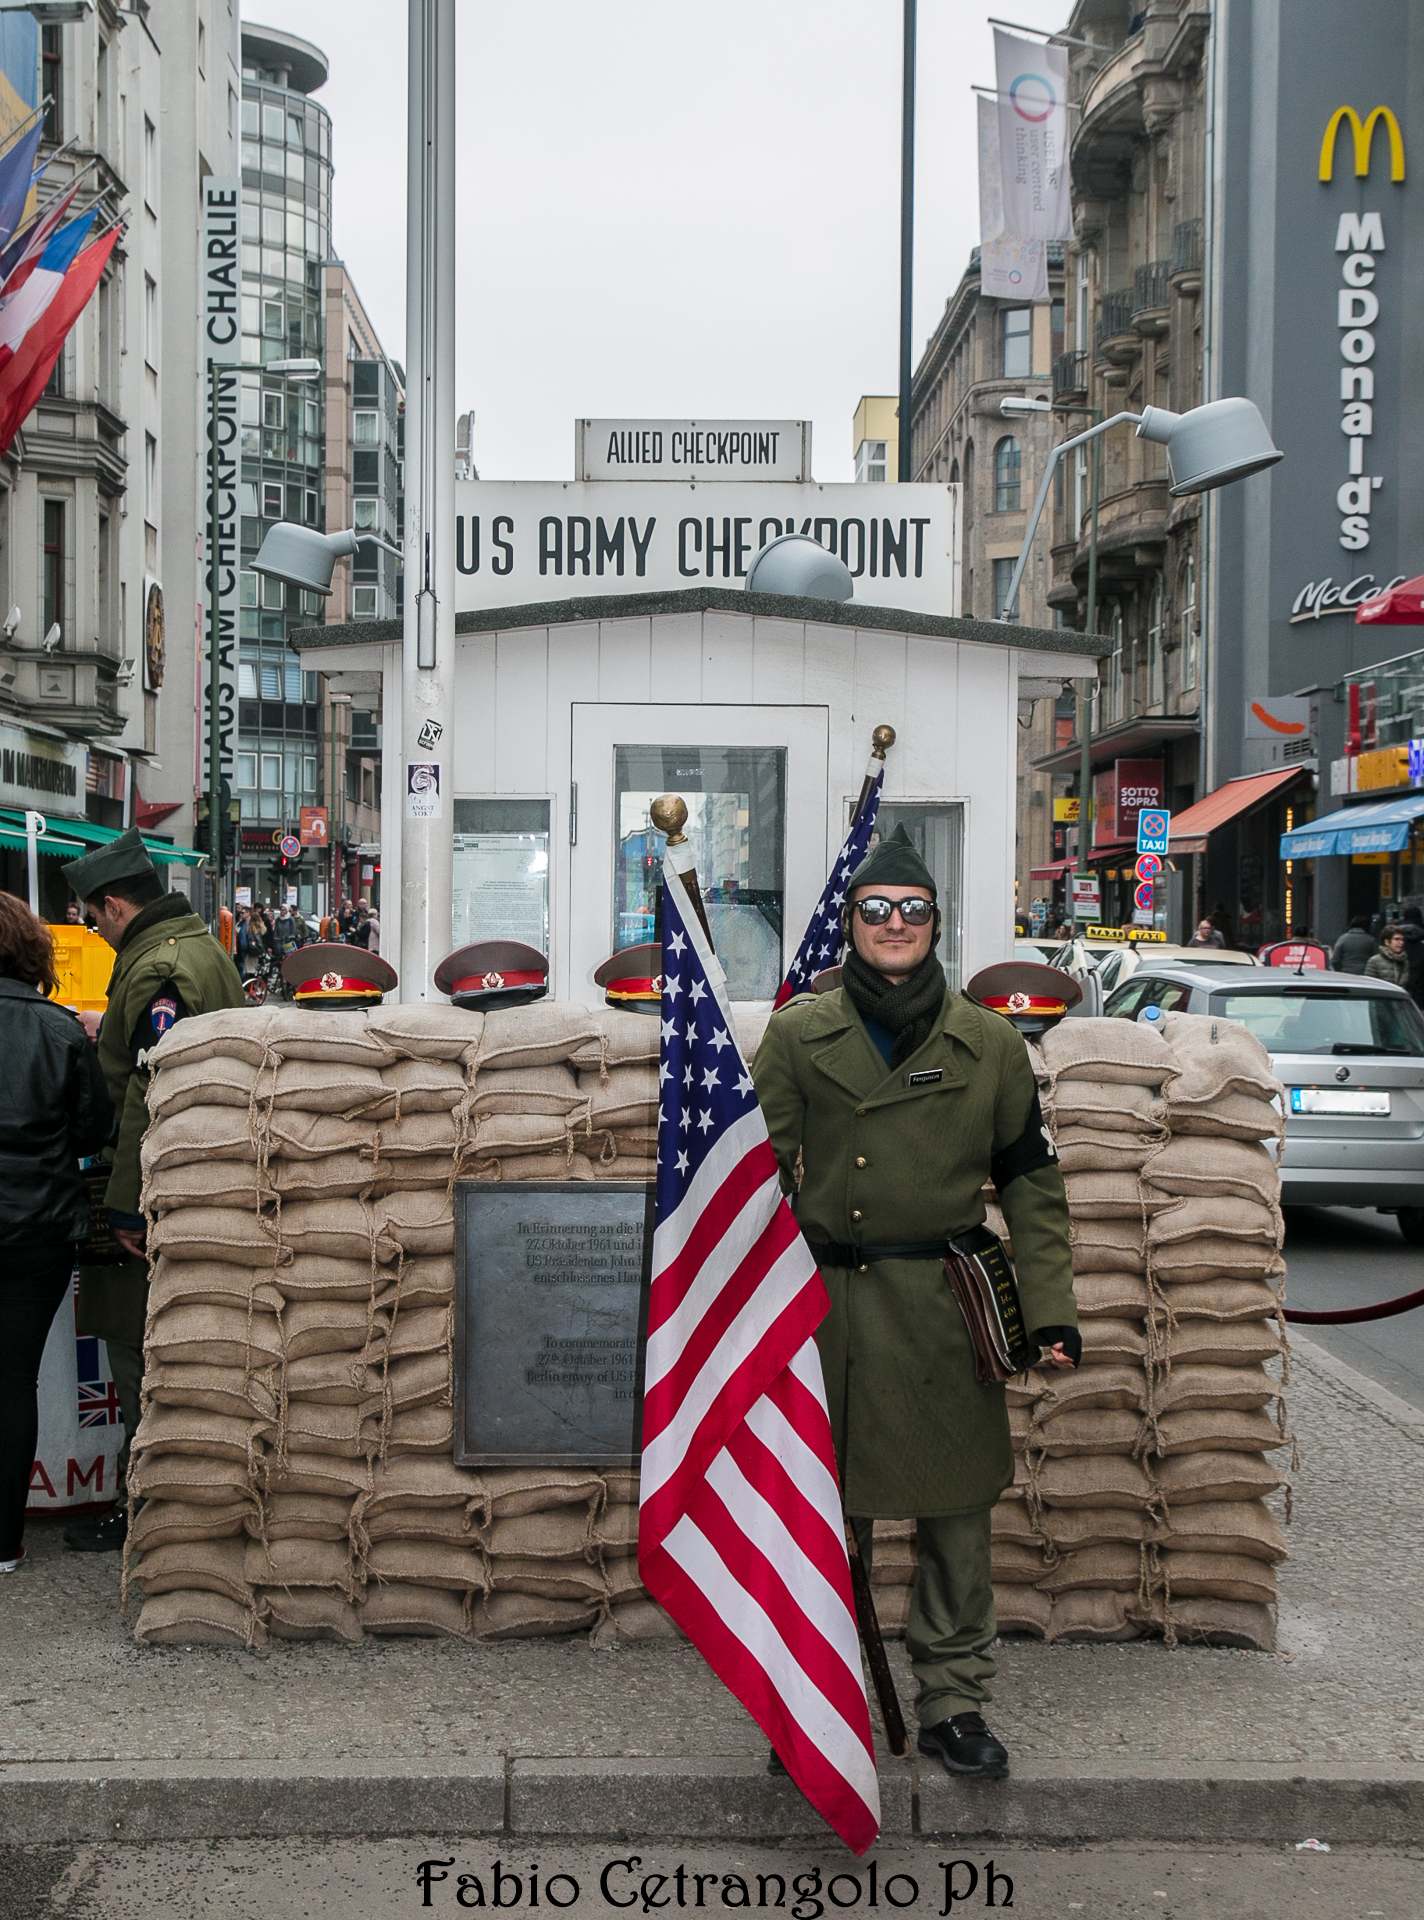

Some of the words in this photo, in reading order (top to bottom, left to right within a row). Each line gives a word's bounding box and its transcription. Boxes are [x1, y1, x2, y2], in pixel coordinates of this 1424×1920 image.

[1030, 129, 1039, 158] user
[1015, 127, 1028, 185] thinking
[1031, 161, 1045, 212] centred
[206, 190, 237, 346] CHARLIE
[1335, 212, 1385, 550] McDonald's
[607, 431, 663, 465] ALLIED
[671, 431, 780, 465] CHECKPOINT
[205, 358, 238, 597] CHECKPOINT
[538, 515, 657, 577] ARMY
[678, 516, 931, 578] CHECPOINT
[205, 609, 236, 672] AM
[204, 681, 235, 780] HAUS
[1121, 787, 1159, 797] SOTTO
[1121, 797, 1159, 807] SOPRA
[1141, 839, 1165, 850] TAXI
[1094, 929, 1120, 937] TAXI
[1137, 932, 1160, 940] TAXI
[913, 1074, 940, 1082] Ferguson
[517, 1222, 530, 1234] In
[533, 1222, 597, 1238] Erinnerung
[600, 1225, 614, 1234] an
[616, 1222, 633, 1234] die
[542, 1239, 585, 1250] Oktober
[588, 1239, 612, 1250] 1961
[613, 1239, 635, 1250] und
[526, 1255, 541, 1267] US
[545, 1254, 607, 1267] Präsidenten
[610, 1254, 635, 1269] John
[534, 1271, 615, 1283] entschlossenes
[543, 1337, 558, 1349] To
[560, 1338, 636, 1349] commemorate
[563, 1353, 607, 1366] October
[610, 1353, 633, 1366] 1961
[527, 1370, 559, 1382] Berlin
[562, 1373, 593, 1386] envoy
[597, 1370, 609, 1382] of
[611, 1370, 626, 1382] US
[615, 1387, 626, 1399] in
